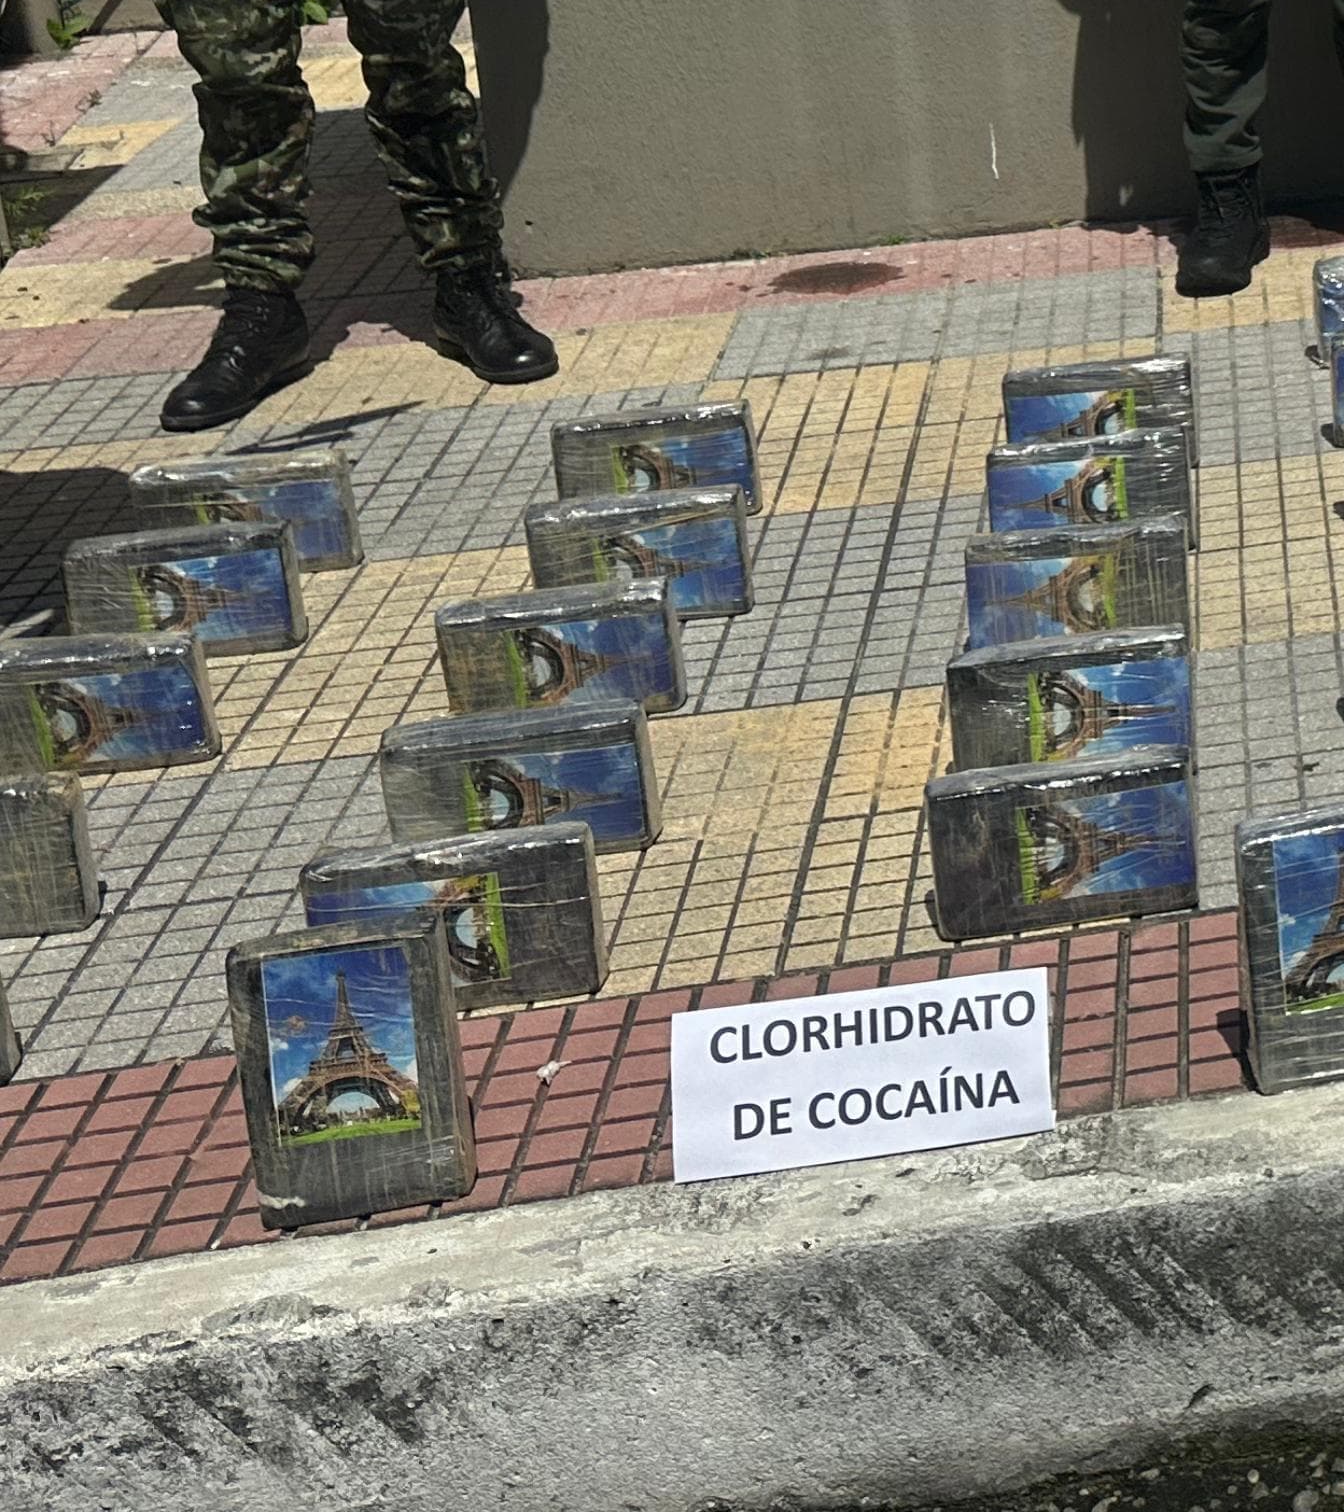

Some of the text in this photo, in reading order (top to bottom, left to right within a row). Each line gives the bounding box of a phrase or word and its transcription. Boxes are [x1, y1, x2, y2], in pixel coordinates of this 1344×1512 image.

[710, 991, 1035, 1064] CLORHIDRATO
[733, 1066, 1020, 1140] DE COCAÍNA
